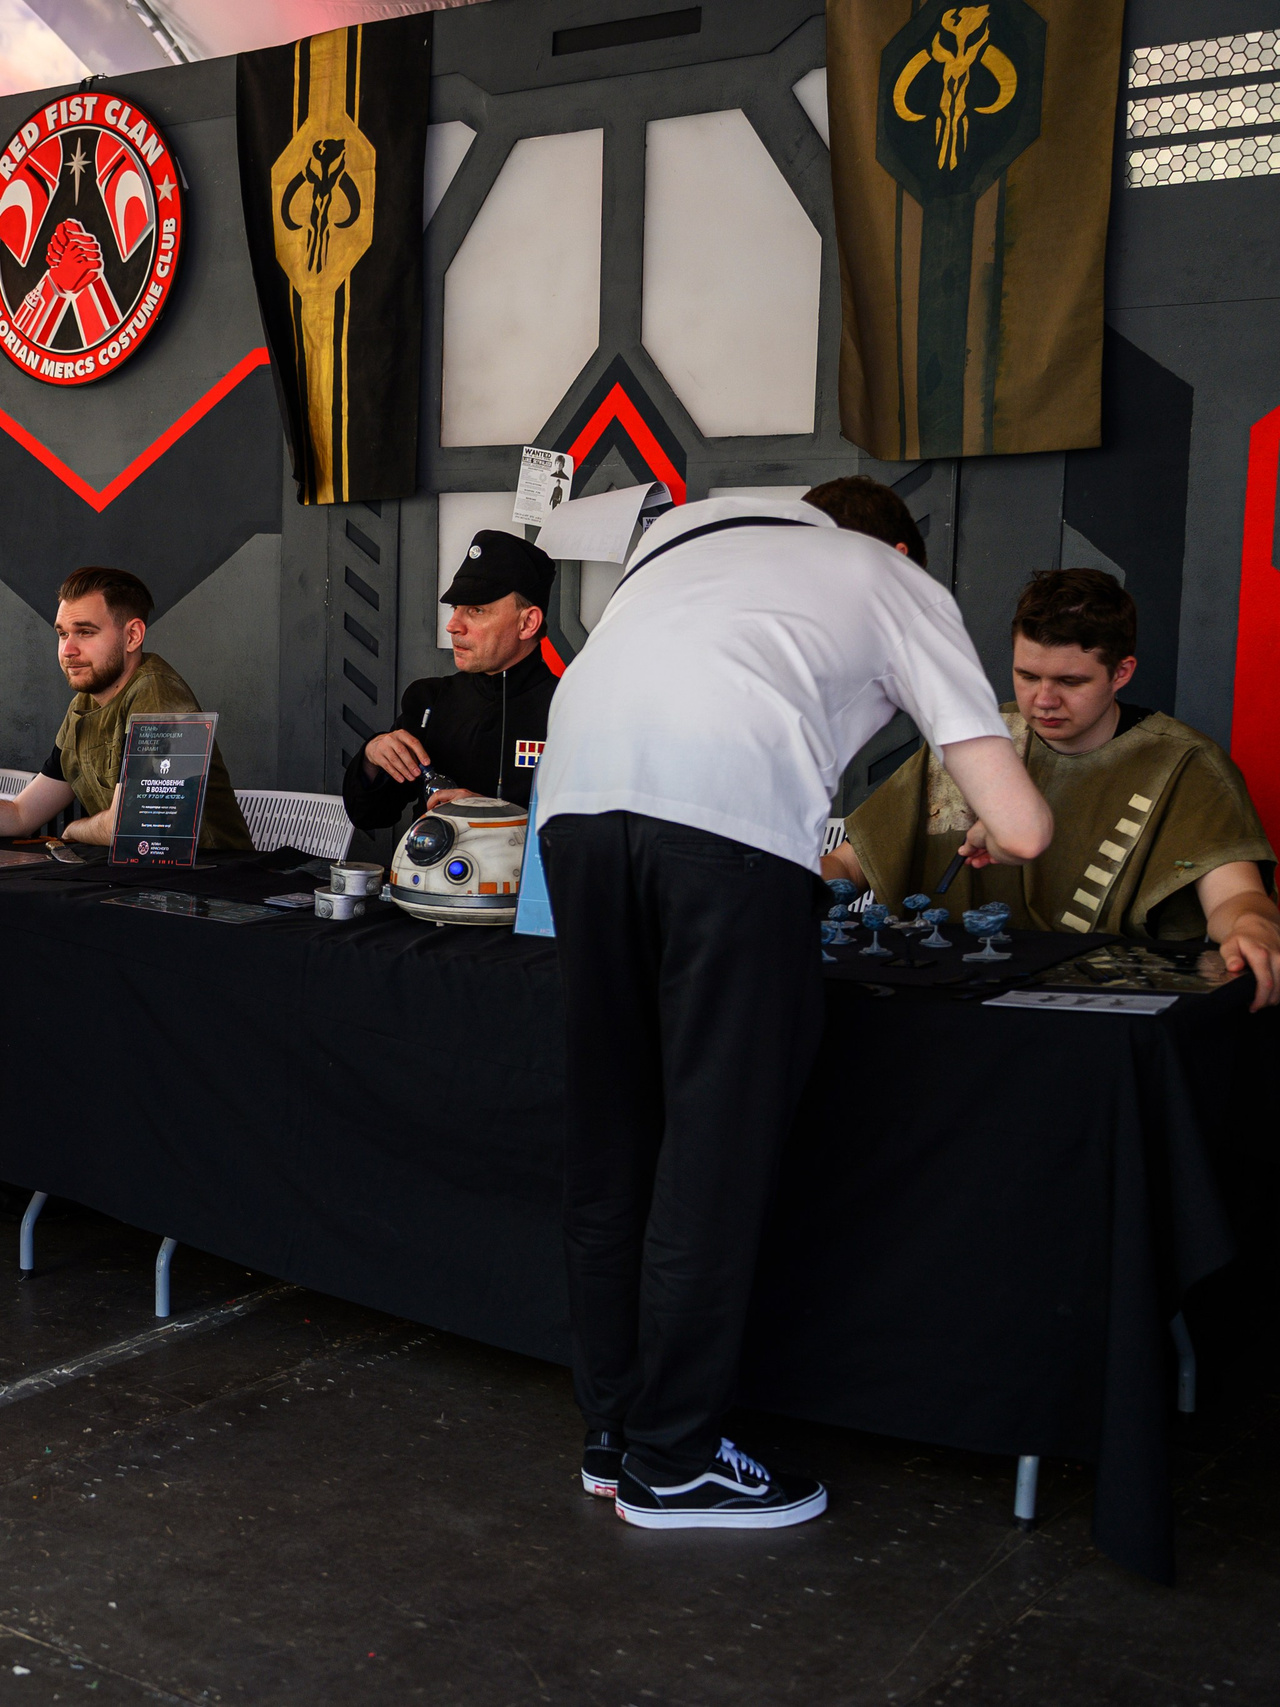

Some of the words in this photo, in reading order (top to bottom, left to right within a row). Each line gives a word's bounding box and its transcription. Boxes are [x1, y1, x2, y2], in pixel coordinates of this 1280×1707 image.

[44, 96, 98, 131] FIST
[104, 99, 165, 167] CLAN
[39, 355, 96, 379] MERCS
[97, 280, 165, 367] COSTUME
[156, 216, 178, 278] CLUB
[524, 447, 552, 459] WANTED
[140, 779, 185, 787] СТОЛКНОВЕНИЕ
[151, 786, 177, 794] ВОЗДУХЕ
